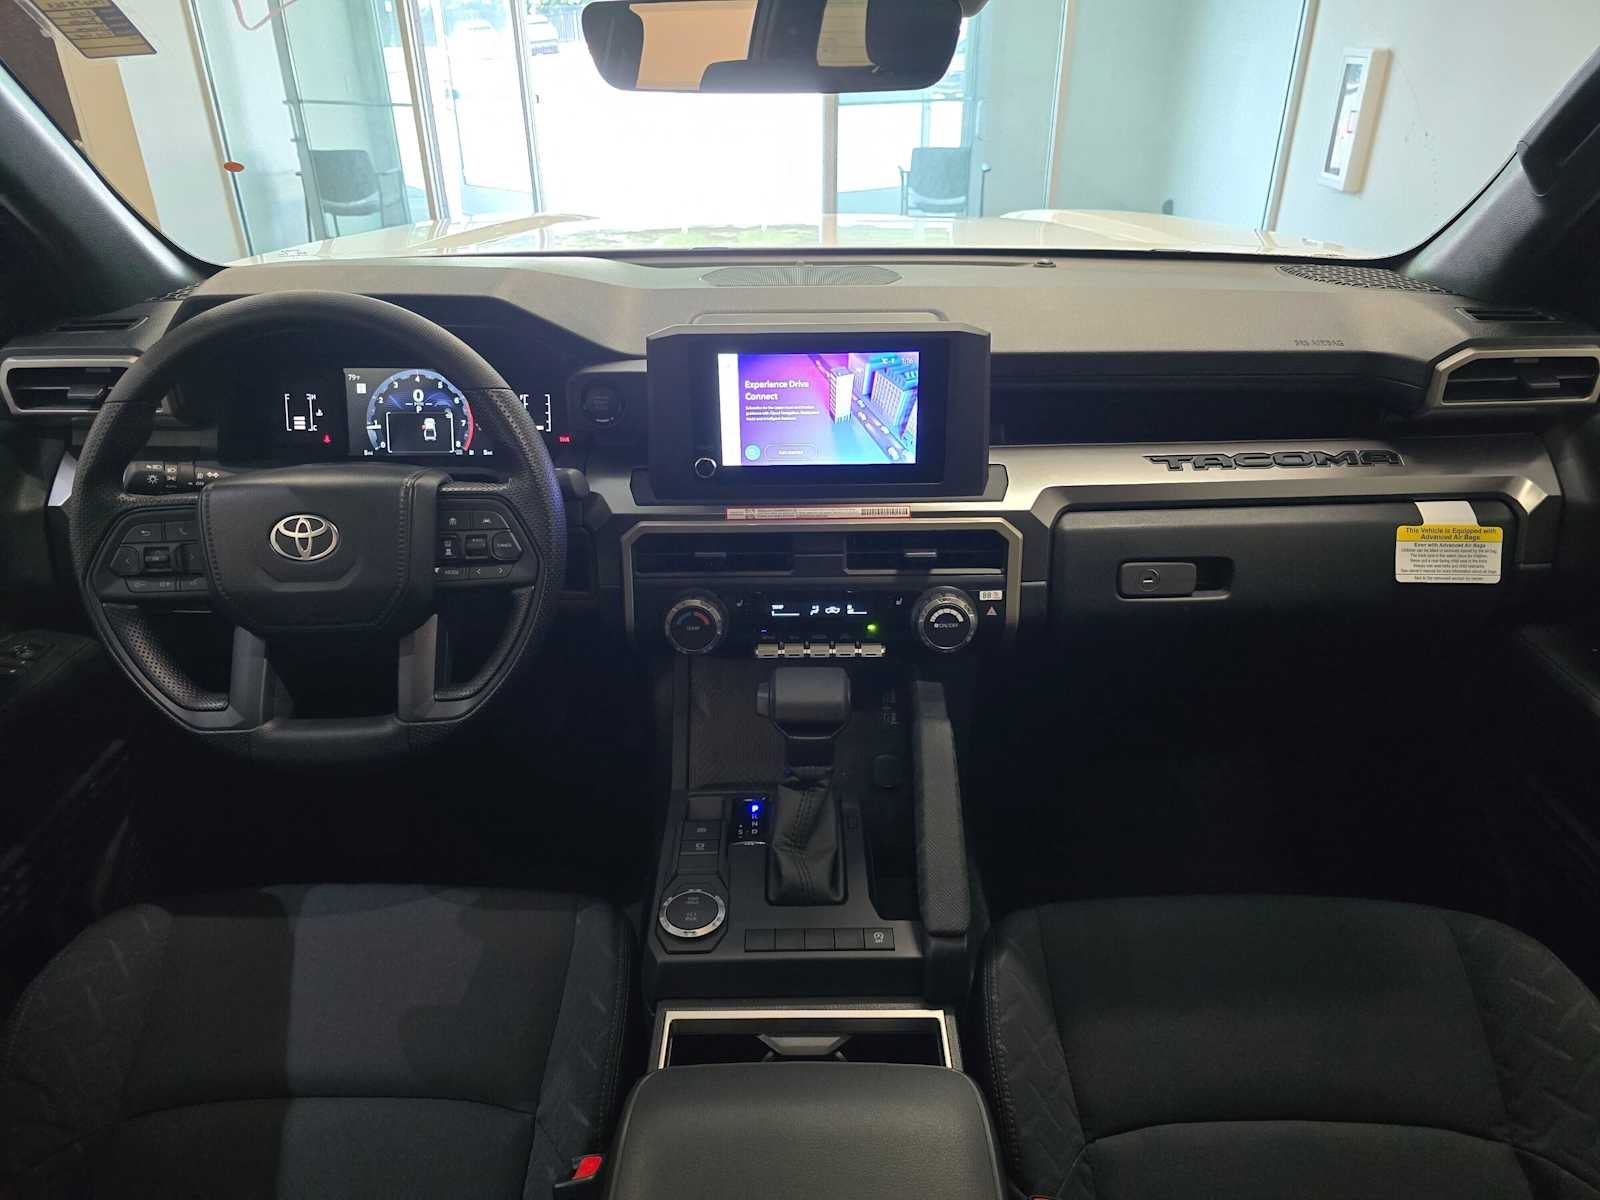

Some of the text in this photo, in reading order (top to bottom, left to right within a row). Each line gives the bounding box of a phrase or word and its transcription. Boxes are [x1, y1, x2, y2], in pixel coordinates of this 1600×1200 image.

[393, 381, 399, 389] 3
[437, 381, 444, 389] 5
[744, 379, 809, 390] Experience Drive
[412, 388, 425, 403] 0
[744, 392, 778, 401] Connect
[416, 406, 423, 414] P
[1142, 449, 1406, 472] TACOMA
[1452, 527, 1482, 536] Equipped
[751, 804, 759, 812] P
